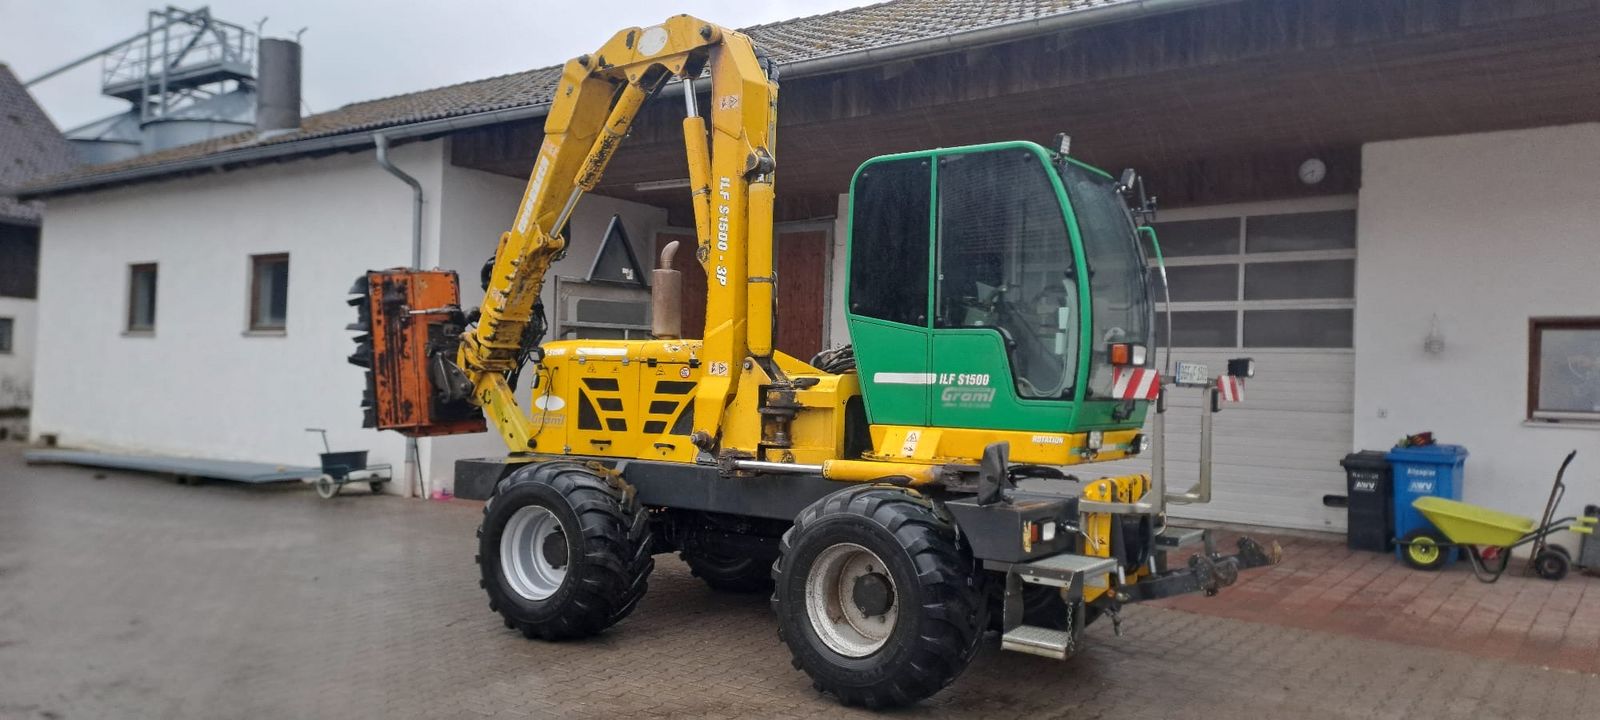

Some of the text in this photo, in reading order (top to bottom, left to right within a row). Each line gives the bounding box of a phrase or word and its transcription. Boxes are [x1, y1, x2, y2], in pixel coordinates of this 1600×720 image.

[719, 175, 730, 201] ILF
[717, 205, 730, 251] S1500
[716, 264, 728, 286] 3P
[939, 372, 990, 386] ILF S1500
